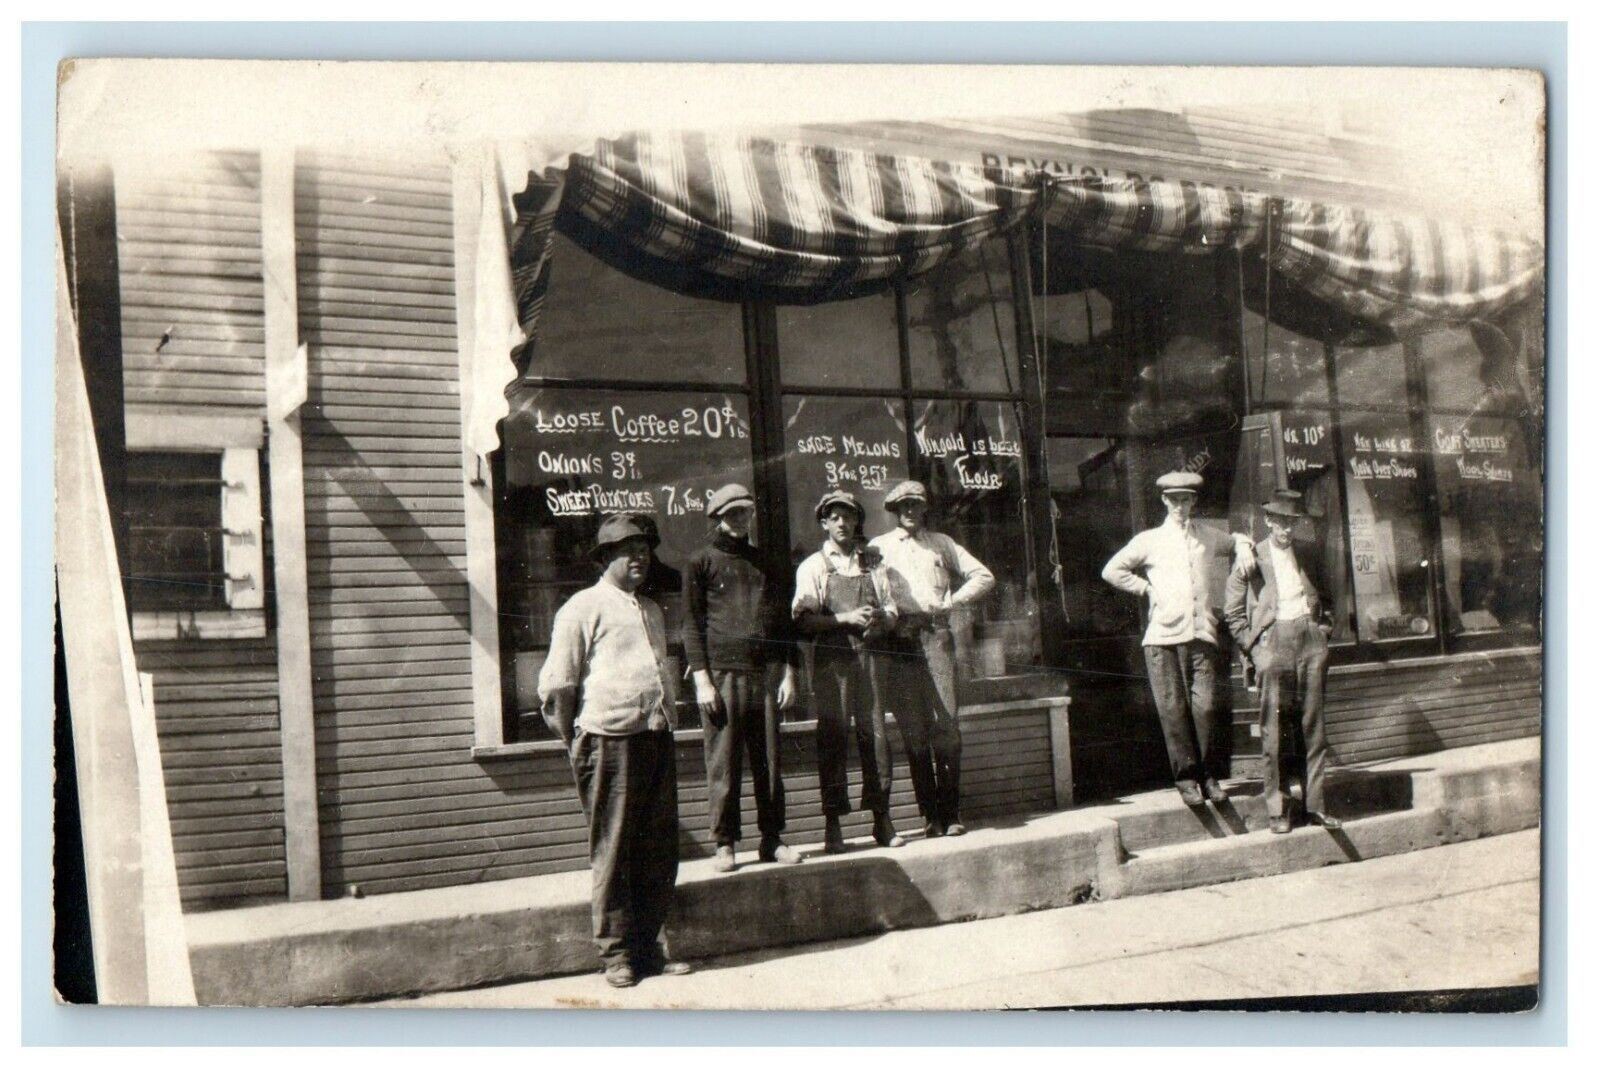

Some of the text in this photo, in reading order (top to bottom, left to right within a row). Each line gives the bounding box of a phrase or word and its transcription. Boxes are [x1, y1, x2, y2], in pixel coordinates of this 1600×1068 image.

[536, 411, 604, 428] LOOSE
[612, 406, 680, 437] Coffee
[842, 436, 900, 458] MELONS
[538, 451, 602, 474] ONIONS
[825, 462, 839, 483] 3
